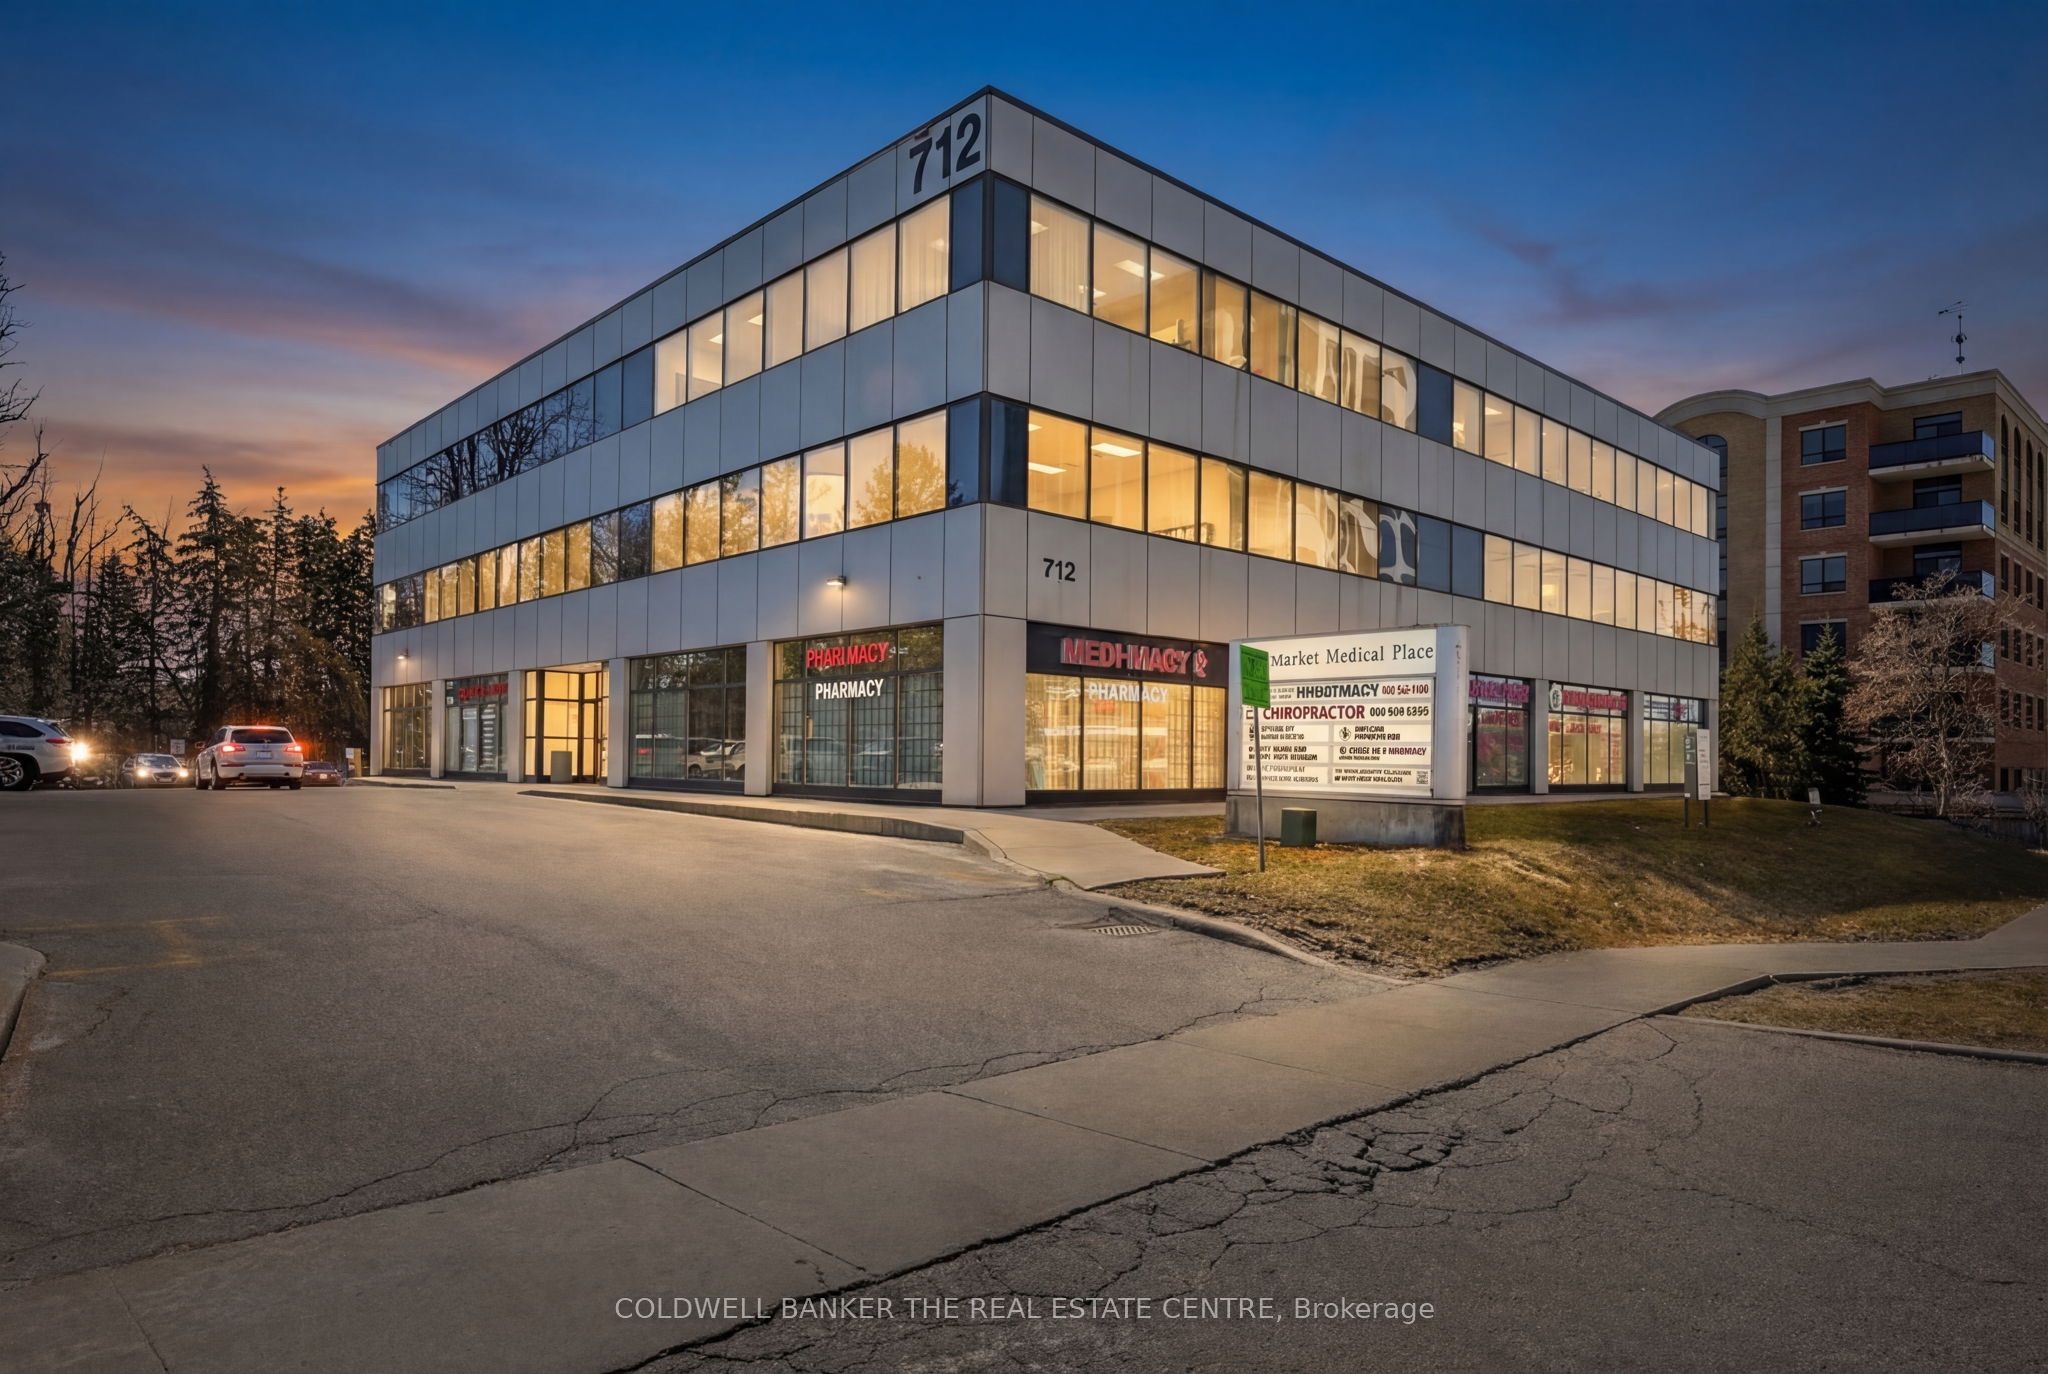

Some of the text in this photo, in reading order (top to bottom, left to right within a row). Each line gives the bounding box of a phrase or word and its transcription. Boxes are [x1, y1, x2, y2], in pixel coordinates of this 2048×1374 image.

[909, 113, 982, 195] 712
[1043, 557, 1076, 582] 712
[1271, 644, 1434, 667] Market Medical Place
[815, 678, 884, 700] PHARMACY
[1087, 682, 1169, 703] PHARMACY
[1263, 705, 1365, 720] CHIROPRACTOR
